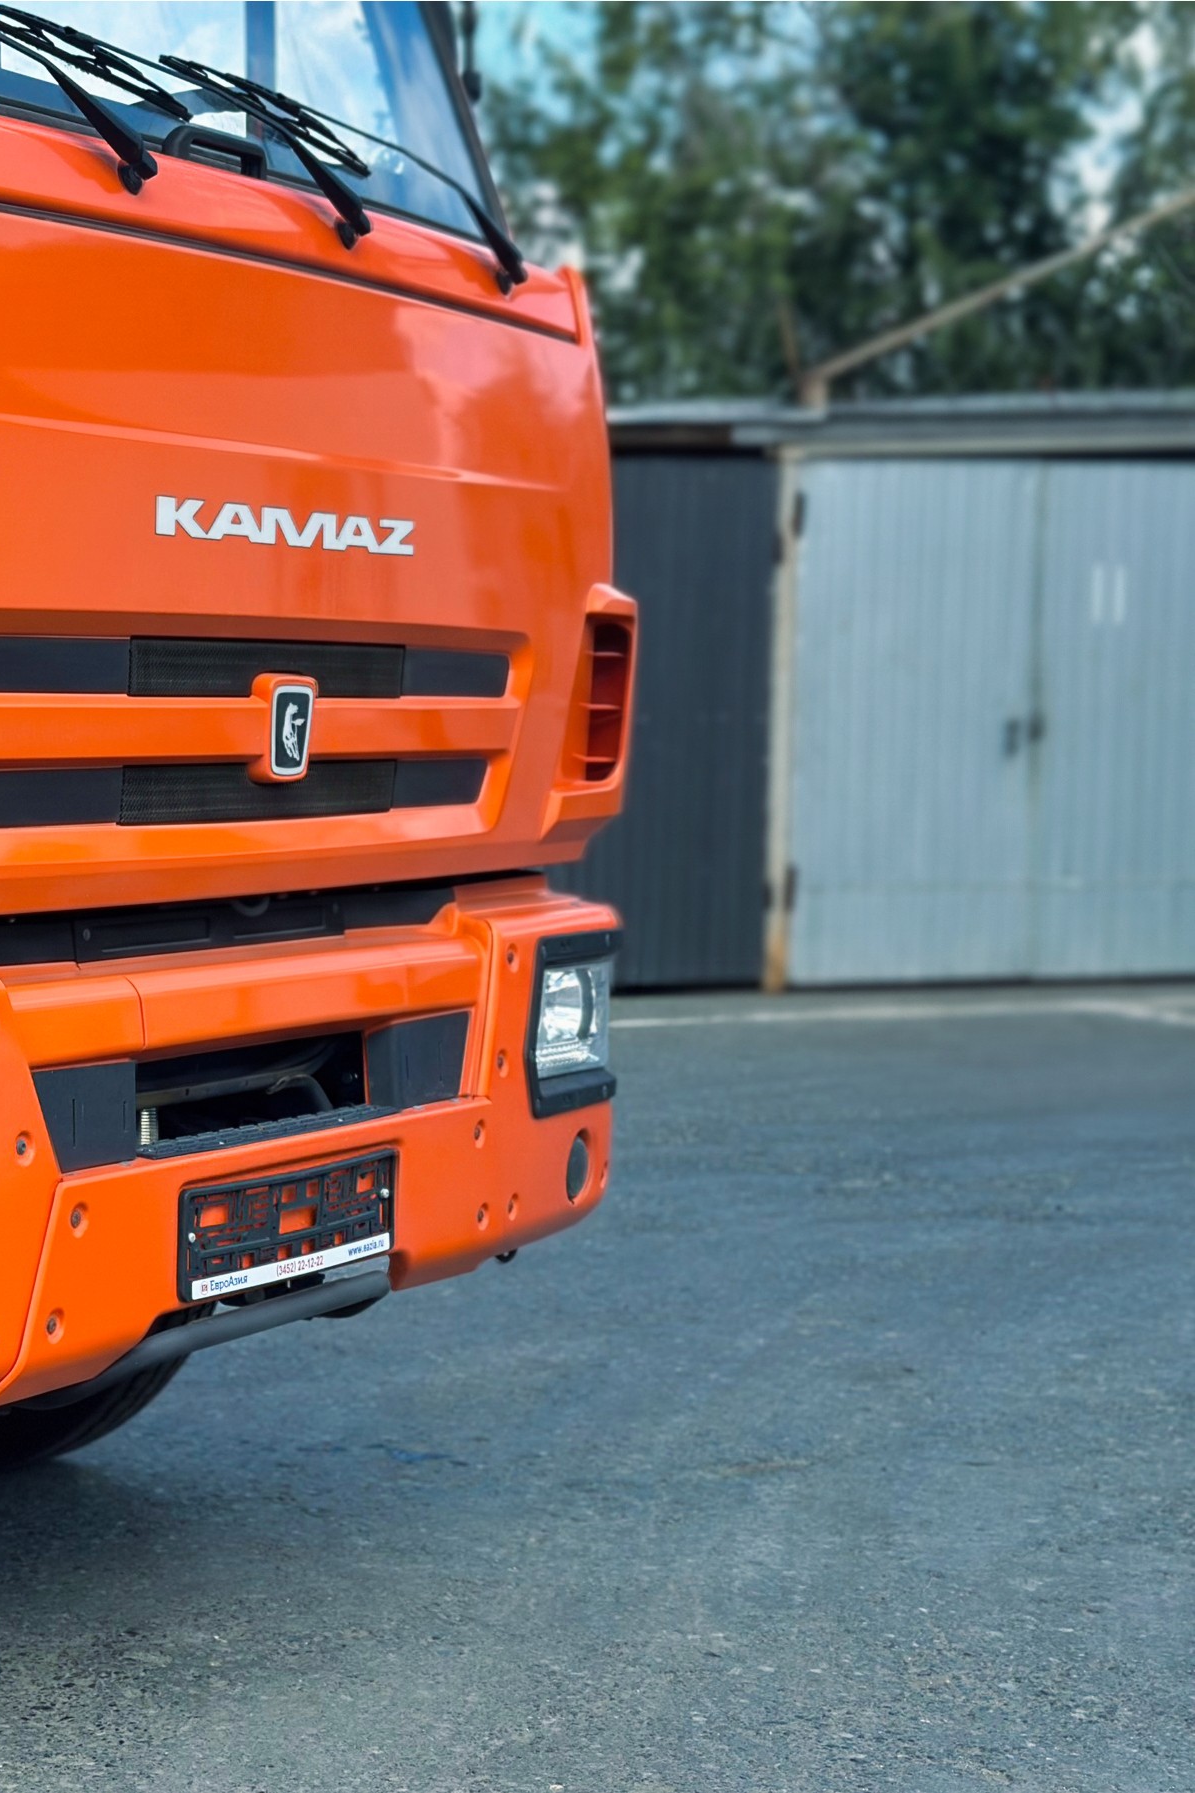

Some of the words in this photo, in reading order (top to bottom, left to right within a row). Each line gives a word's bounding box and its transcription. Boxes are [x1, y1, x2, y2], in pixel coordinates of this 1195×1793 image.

[155, 495, 414, 556] KAMAZ
[276, 1261, 296, 1277] (3452)
[297, 1255, 324, 1271] 22-12-22
[209, 1275, 248, 1292] ЕвроАзия
